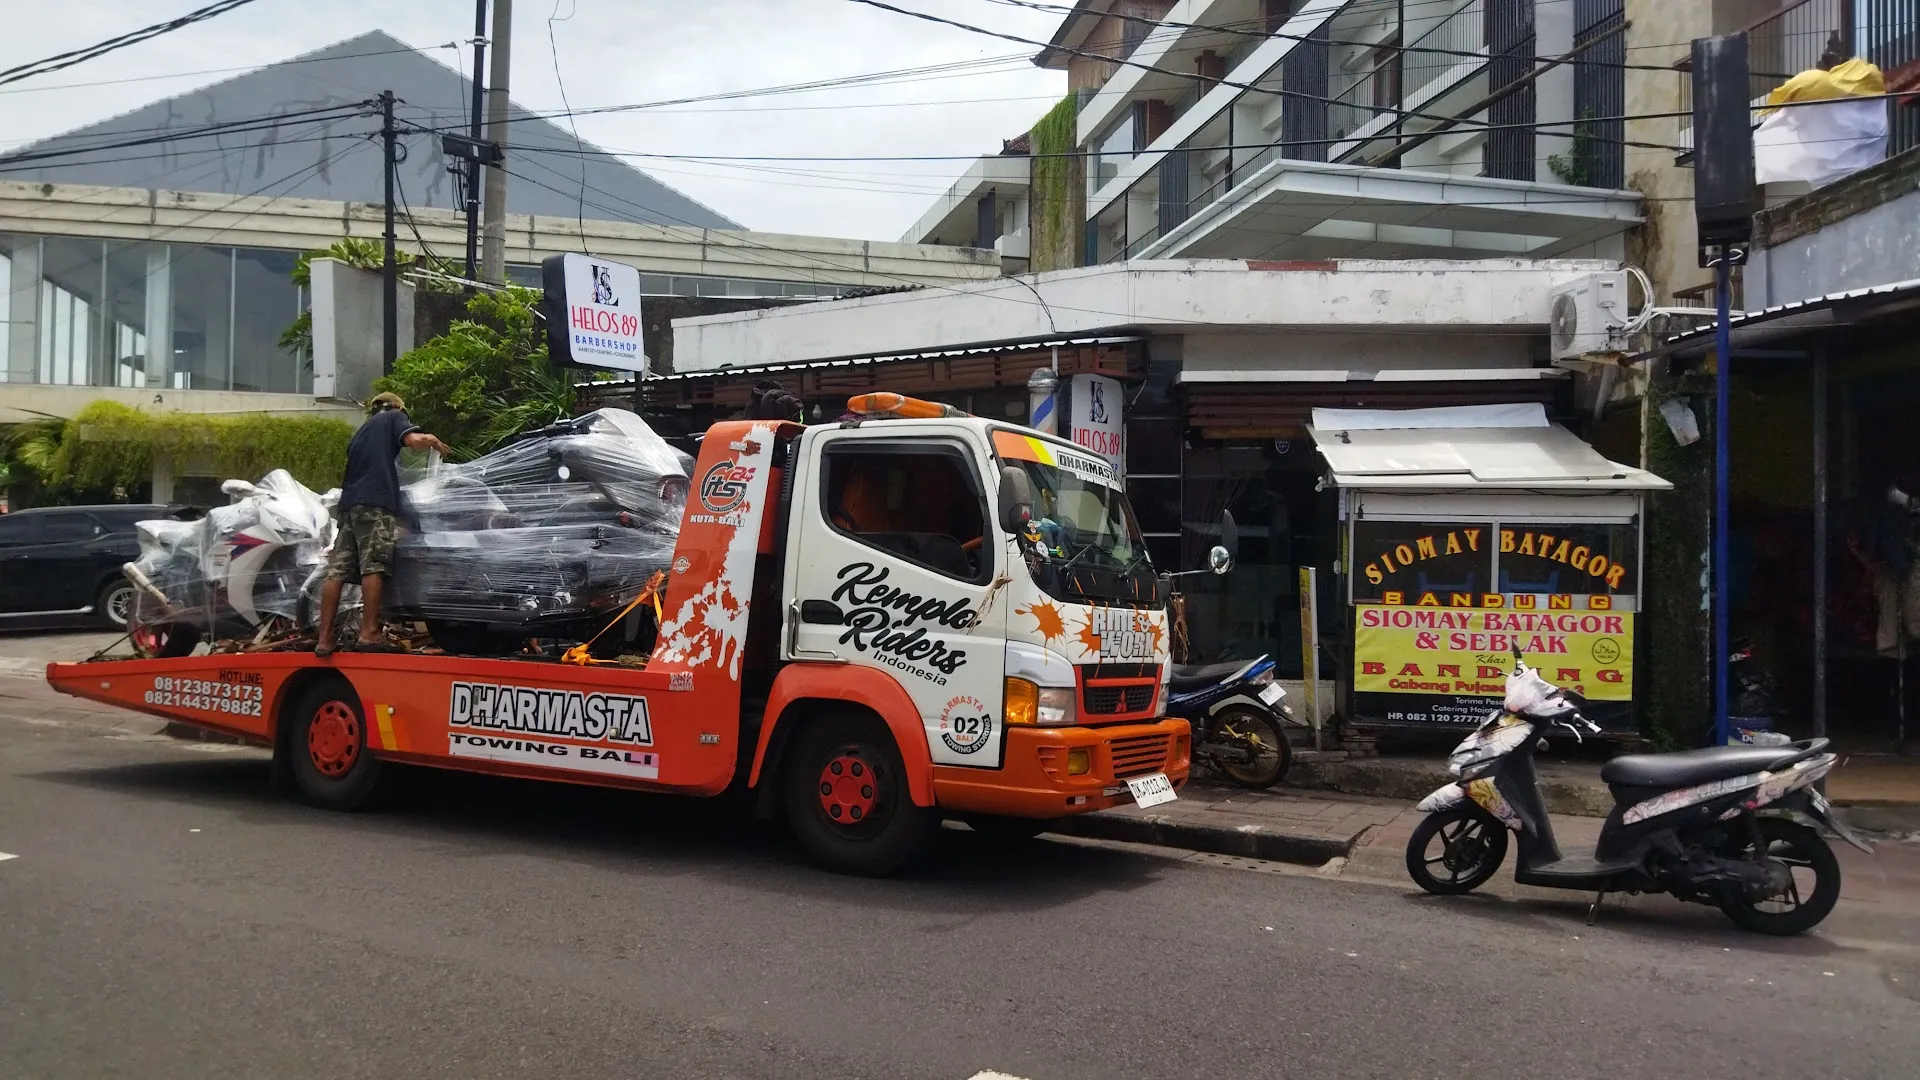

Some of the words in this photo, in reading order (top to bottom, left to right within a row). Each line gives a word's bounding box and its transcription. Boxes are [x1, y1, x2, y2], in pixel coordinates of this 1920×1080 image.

[572, 305, 619, 334] HELOS
[621, 314, 638, 337] 89
[575, 334, 637, 352] BARBERSHOP
[1109, 432, 1120, 456] 89
[1365, 528, 1481, 586] SIOMAY
[1499, 530, 1626, 589] BATAGOR
[1382, 591, 1612, 610] BANDUNG
[1362, 610, 1473, 630] SIOMAY
[1483, 613, 1625, 634] BATAGOR
[838, 607, 967, 676] Riders
[1415, 632, 1440, 650] &
[872, 649, 948, 687] Indonesia
[1475, 654, 1507, 664] Khas
[1362, 661, 1624, 683] BANDNG
[154, 676, 263, 701] 08123873173
[1388, 678, 1450, 693] Cabang
[145, 690, 262, 717] 082144379882
[450, 681, 654, 745] DHARMASTA
[940, 695, 984, 729] DHARMASTA
[1432, 705, 1468, 714] Catering
[954, 716, 979, 735] 02
[1407, 713, 1427, 721] 082
[1430, 714, 1450, 723] 120
[944, 735, 972, 754] TOWING
[972, 717, 991, 751] STORING
[451, 734, 568, 756] TOWING
[579, 748, 652, 765] BALI
